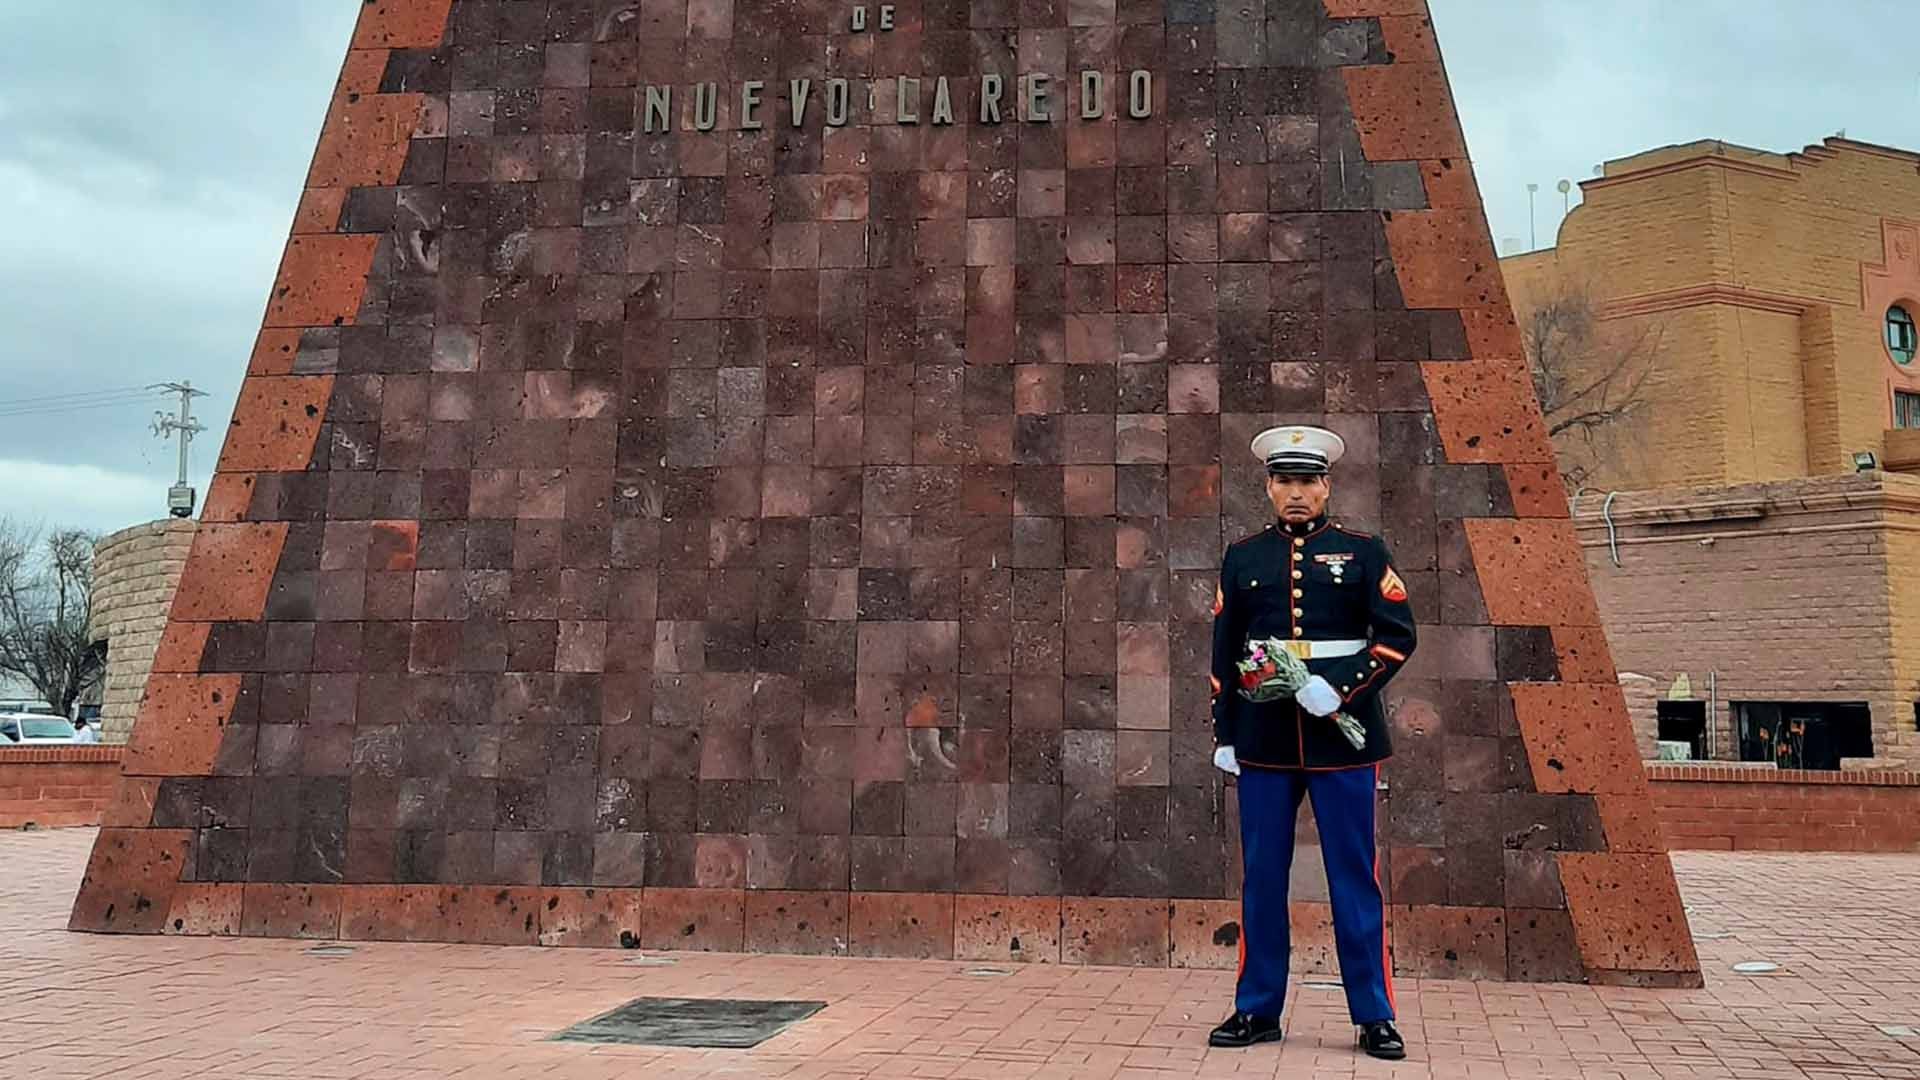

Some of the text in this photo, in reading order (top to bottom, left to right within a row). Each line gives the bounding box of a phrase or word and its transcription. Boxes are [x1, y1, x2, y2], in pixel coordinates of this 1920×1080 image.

[851, 4, 895, 31] DE
[644, 69, 1153, 134] NUEVO LAREDO
